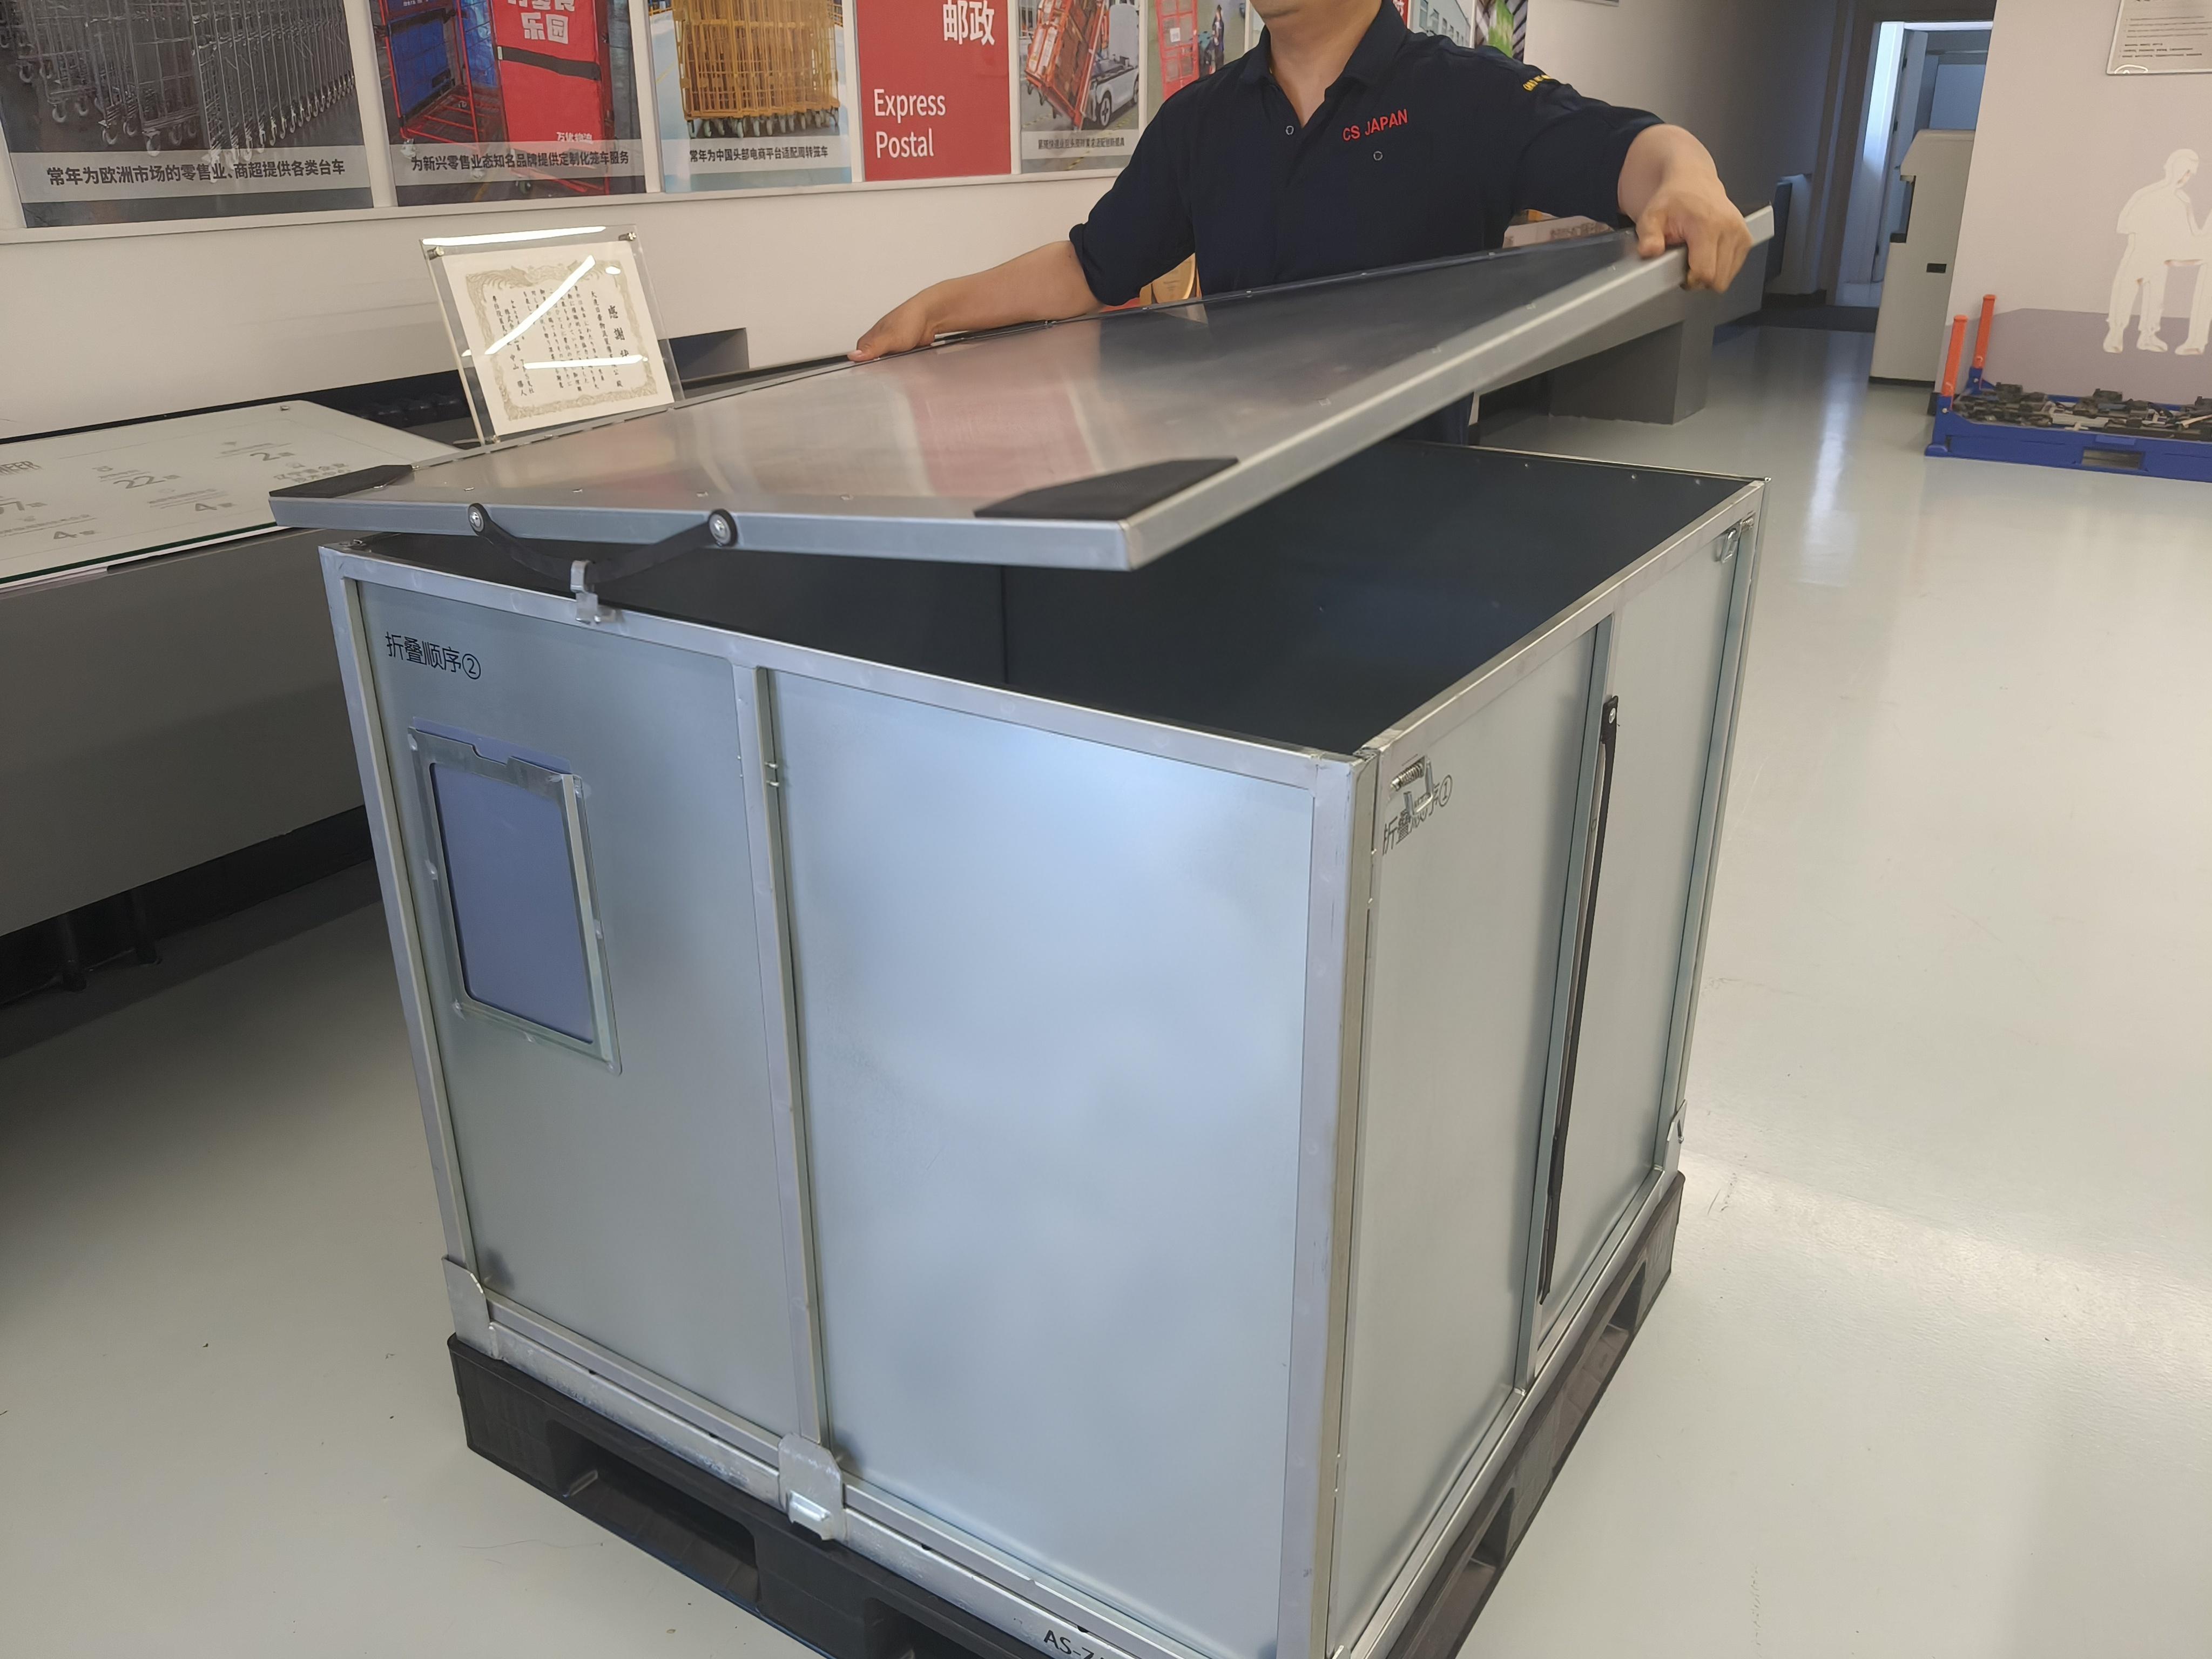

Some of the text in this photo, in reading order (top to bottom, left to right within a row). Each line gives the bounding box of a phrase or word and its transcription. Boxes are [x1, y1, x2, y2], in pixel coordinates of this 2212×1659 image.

[521, 12, 568, 44] 乐园
[943, 0, 995, 45] 邮政
[874, 89, 946, 124] Express
[1343, 109, 1408, 141] CS JAPAN
[876, 127, 934, 158] Postal
[46, 159, 346, 186] 常年为欧洲市场的零售业、商超提供各类台车
